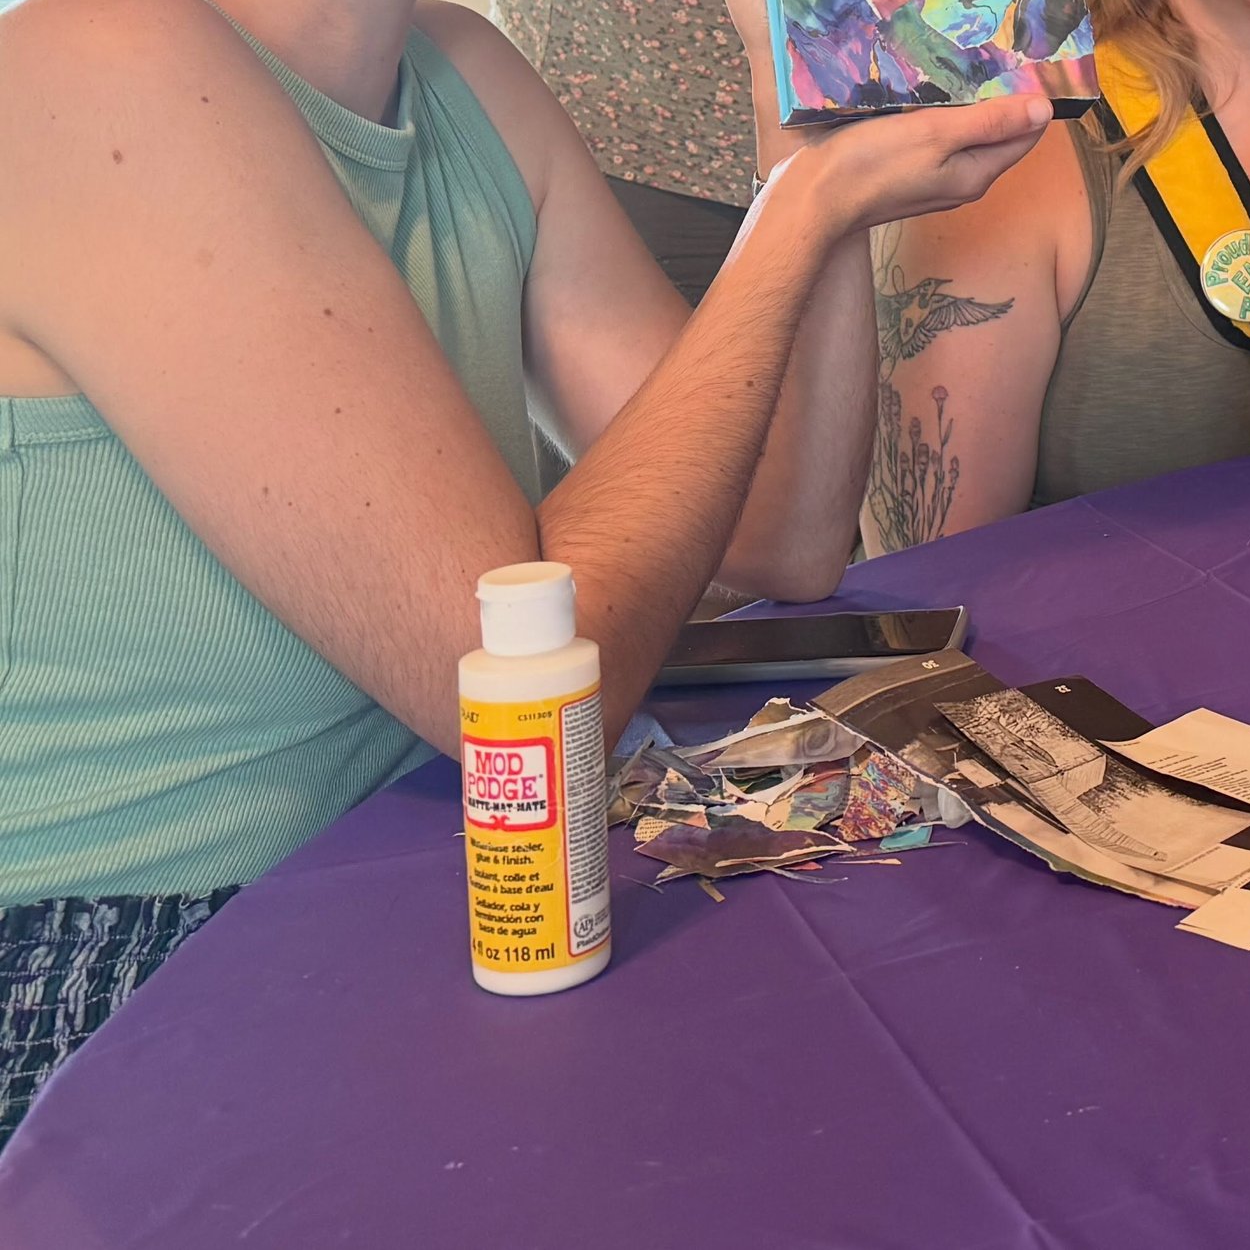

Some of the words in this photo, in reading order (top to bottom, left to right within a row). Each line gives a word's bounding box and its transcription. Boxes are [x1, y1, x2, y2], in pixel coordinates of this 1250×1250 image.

[1205, 233, 1250, 287] Proud
[475, 750, 523, 776] MOD
[468, 772, 538, 800] PODGE
[512, 843, 544, 852] sealer,
[493, 855, 499, 864] &
[502, 855, 534, 865] finish.
[503, 873, 526, 882] colle
[529, 872, 540, 881] et
[500, 885, 522, 894] base
[526, 883, 554, 893] d'eau
[510, 902, 531, 911] cola
[533, 903, 540, 913] y
[525, 914, 544, 923] con
[497, 926, 508, 935] de
[511, 928, 537, 938] agua
[486, 947, 500, 960] oz
[505, 946, 530, 962] 118
[535, 943, 555, 960] ml
